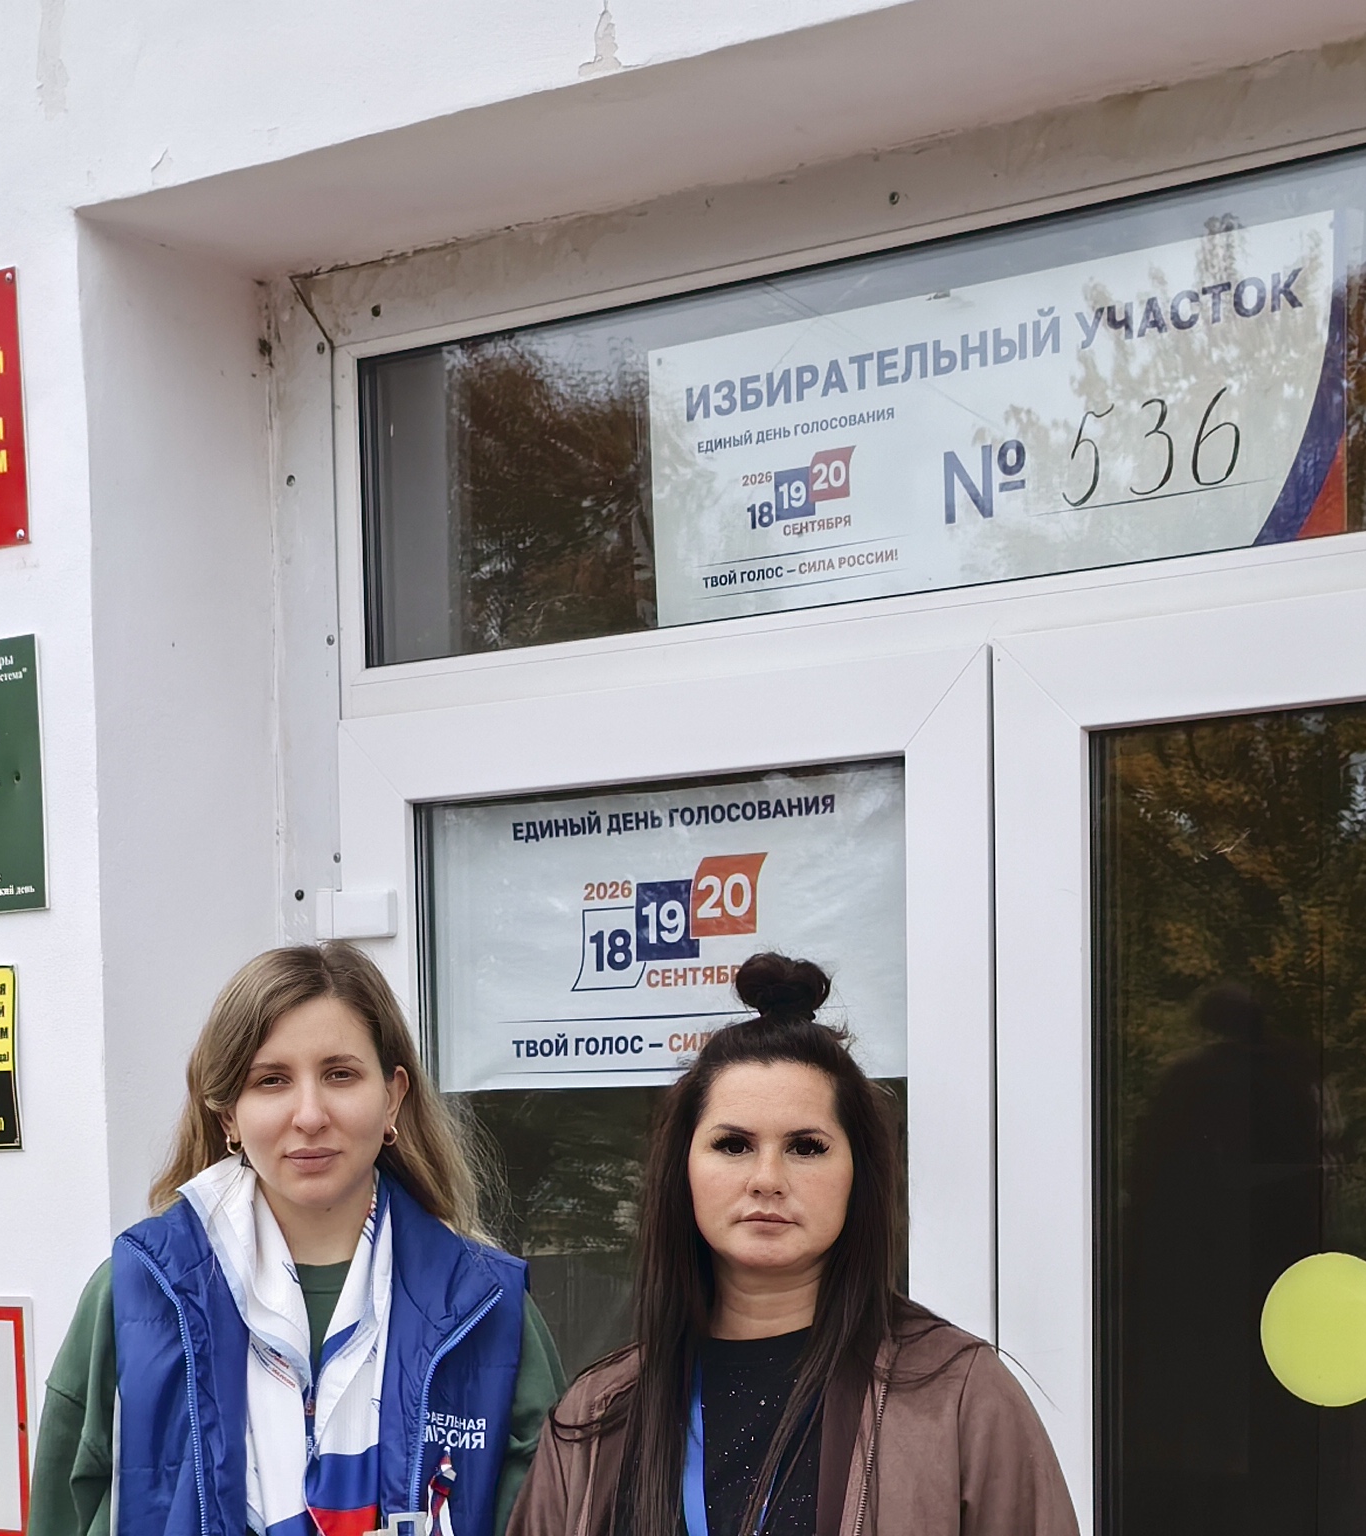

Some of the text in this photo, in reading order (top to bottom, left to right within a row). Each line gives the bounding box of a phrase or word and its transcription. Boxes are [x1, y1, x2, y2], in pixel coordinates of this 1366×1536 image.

[686, 267, 1304, 422] ИЗБИРАТЕЛЬНЫЙ УЧАСТОК
[697, 407, 895, 454] ЕДИНЫЙ ДЕНЬ ГОЛОСОВАНИЯ
[943, 386, 1241, 525] № 536
[742, 471, 773, 487] 2026
[746, 460, 846, 530] 18 19 20
[782, 515, 852, 537] СЕНТЯБРЯ
[702, 569, 737, 589] ТВОЙ
[740, 565, 784, 584] ГОЛОС
[798, 559, 834, 575] СИЛА
[838, 548, 899, 569] РОССИИ!
[511, 794, 836, 843] ЕДИНЫЙ ДЕНЬ ГОЛОСОВАНИЯ
[583, 880, 633, 901] 2026
[589, 872, 753, 973] 18 19 20
[646, 965, 742, 988] СЕНТЯБР
[511, 1033, 569, 1058] ТВОЙ
[574, 1035, 644, 1057] ГОЛОС
[668, 1032, 713, 1053] СИЛ
